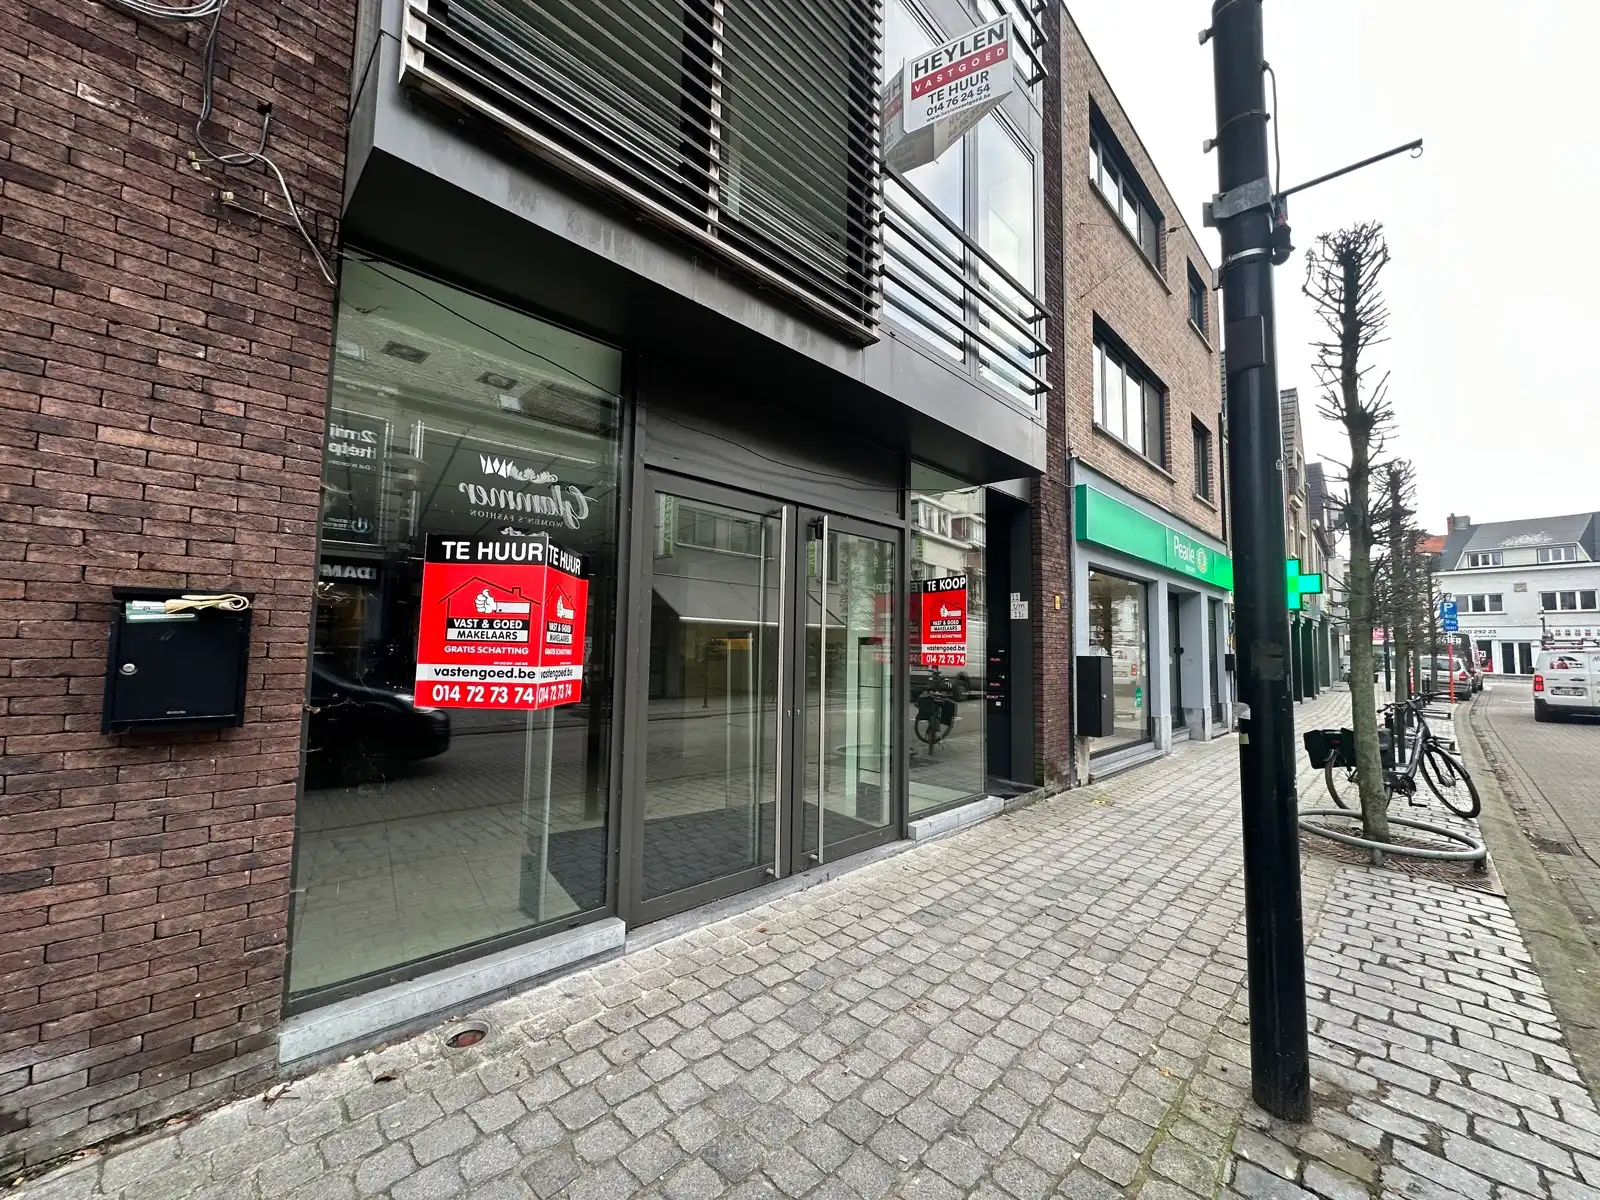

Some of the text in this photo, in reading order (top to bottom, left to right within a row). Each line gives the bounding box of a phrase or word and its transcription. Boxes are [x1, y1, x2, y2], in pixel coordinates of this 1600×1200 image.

[914, 23, 1004, 79] HEYLEN
[914, 47, 1005, 92] VASTGOED
[928, 70, 989, 105] TE HUUR
[926, 83, 991, 116] 014 76 24 54
[442, 541, 544, 561] TE HUUR
[1173, 535, 1195, 564] Pearle
[549, 544, 581, 575] TE HUUR
[927, 577, 966, 592] TE KOOP
[1443, 602, 1453, 612] P
[453, 618, 523, 630] VAST & GOED
[548, 622, 558, 632] VAST
[561, 624, 572, 633] GOED
[456, 629, 518, 641] MAKELAARS
[444, 645, 529, 655] GRATIS SCHATTING
[926, 655, 965, 664] 014 72 73 74
[434, 667, 536, 680] vastengoed.be
[540, 669, 573, 681] vastengoed.be
[432, 685, 534, 704] 014 72 73 74
[550, 685, 557, 700] 72
[557, 684, 565, 699] 73
[565, 683, 572, 697] 74
